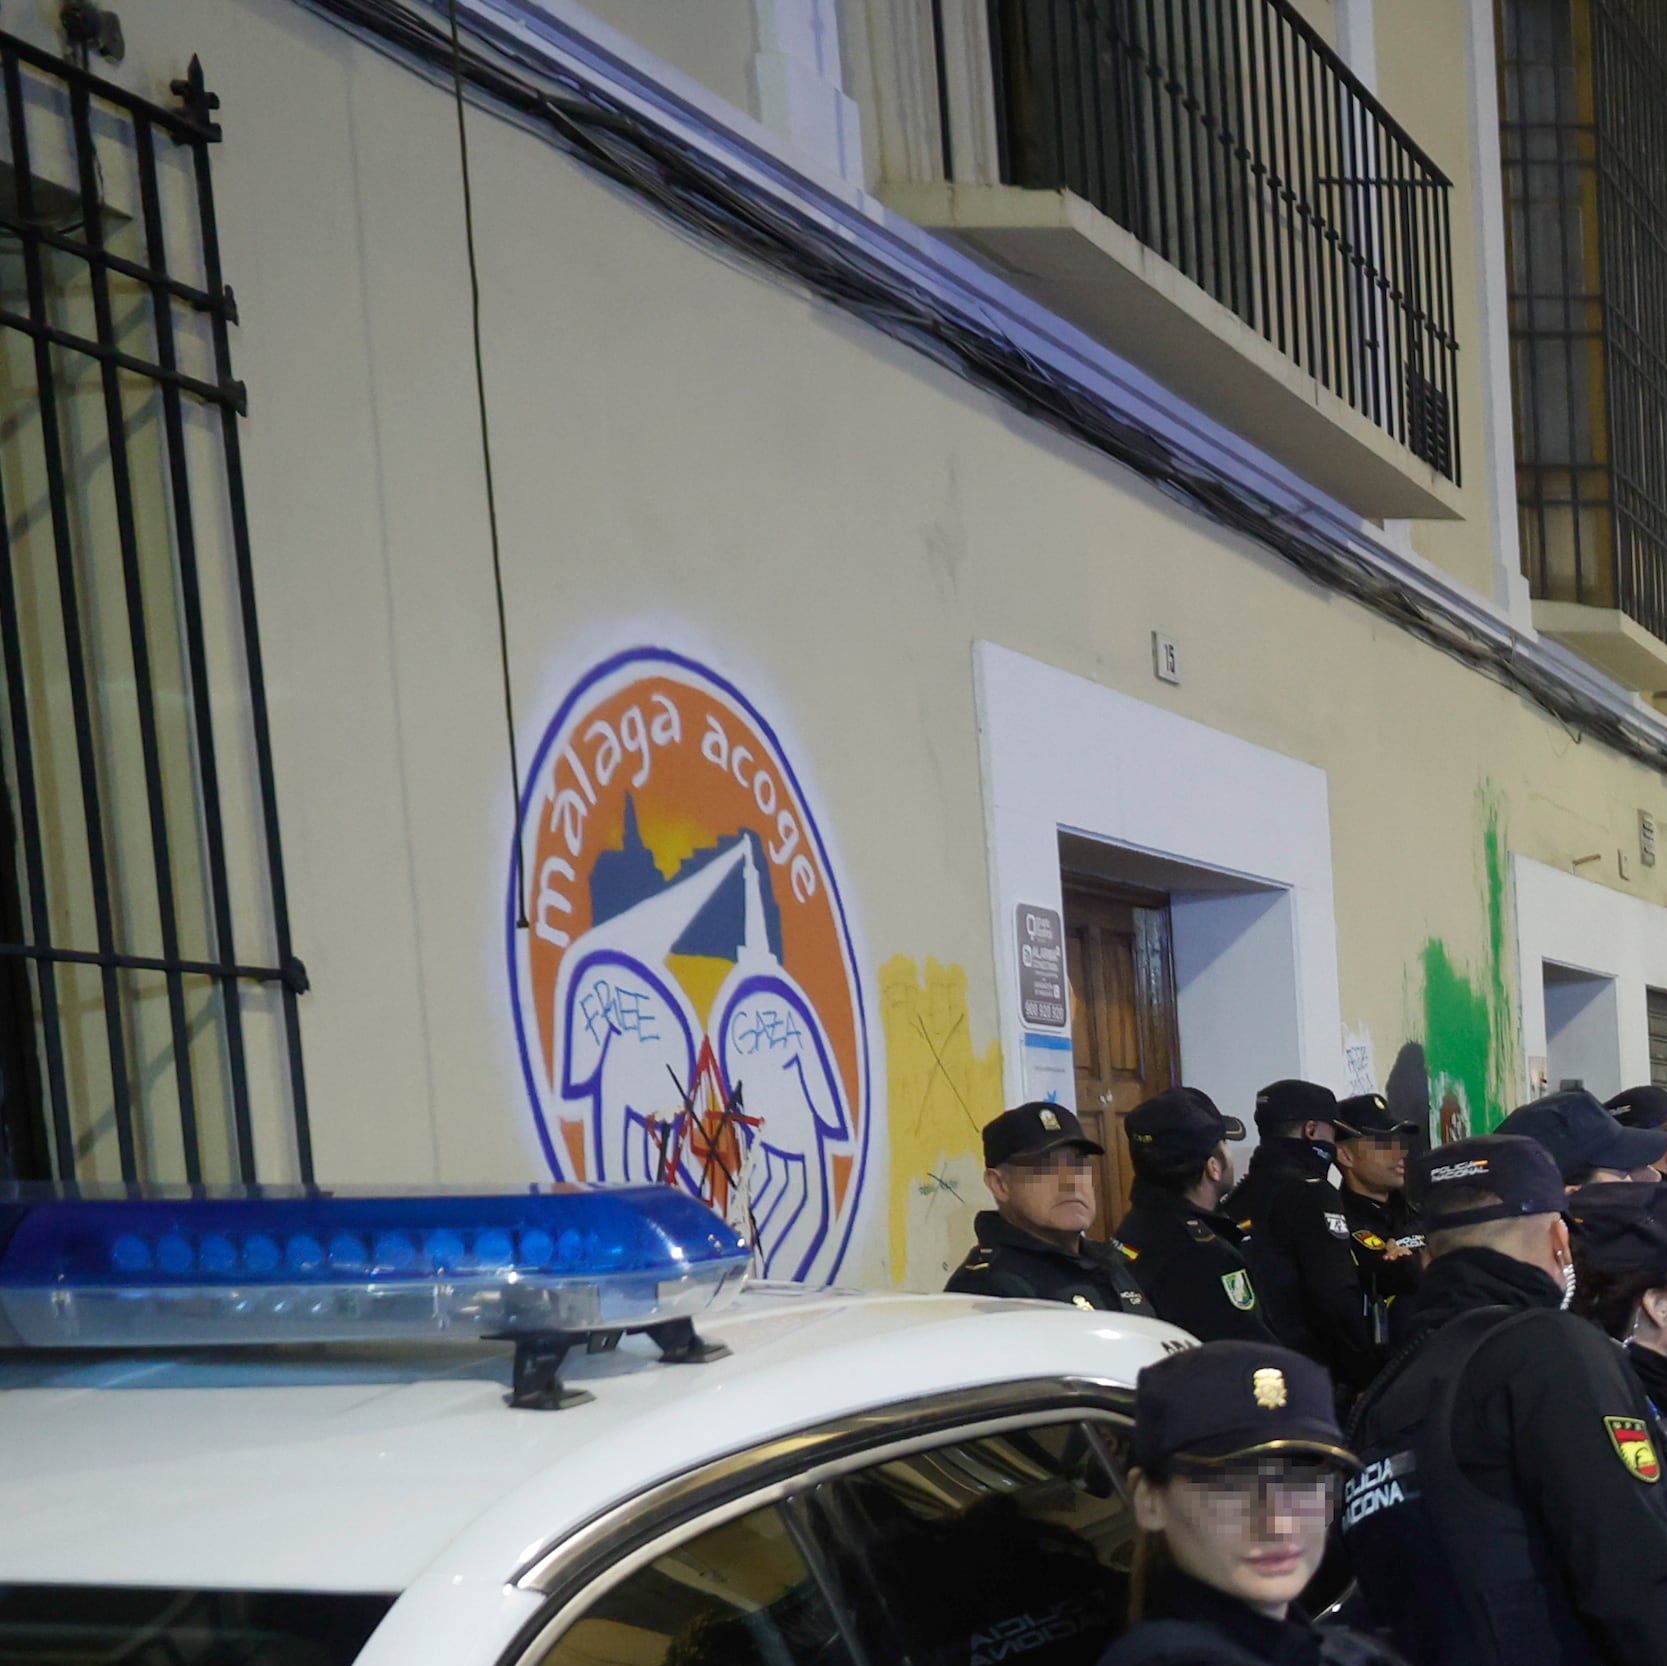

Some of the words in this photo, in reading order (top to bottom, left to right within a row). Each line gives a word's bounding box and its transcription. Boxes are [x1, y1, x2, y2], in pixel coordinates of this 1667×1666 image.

[1164, 643, 1176, 674] 15
[701, 713, 817, 904] acoge
[579, 979, 661, 1046] FREE
[731, 1010, 804, 1055] GAZA
[1341, 1479, 1422, 1535] ACIONA
[1344, 1456, 1393, 1504] OLICIA
